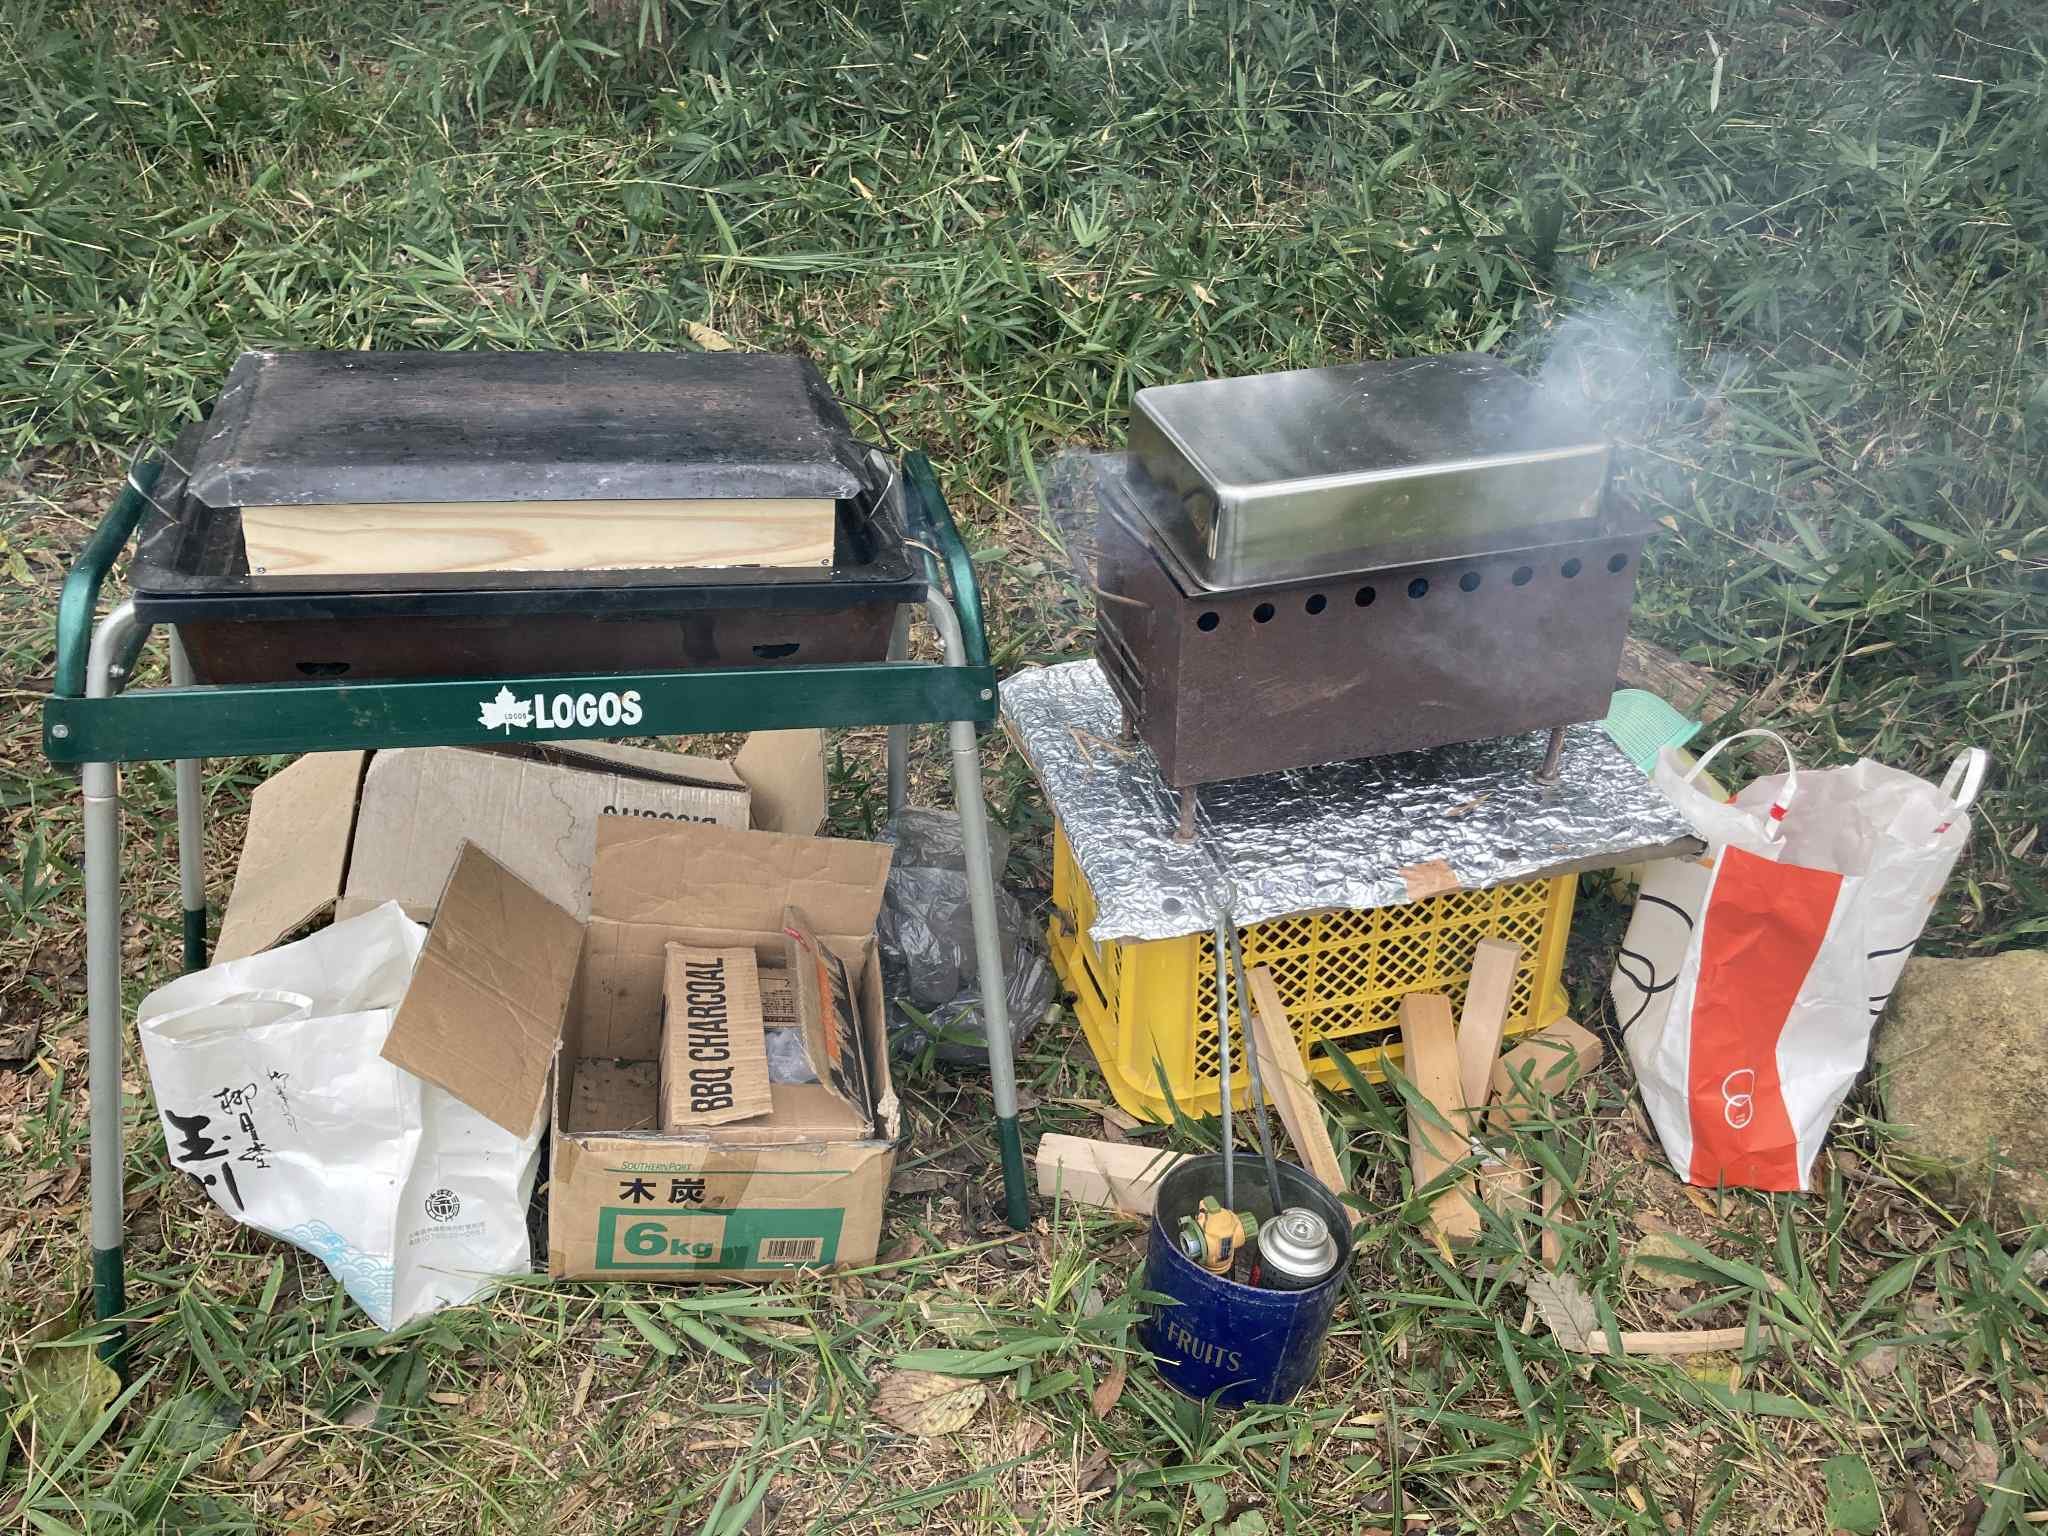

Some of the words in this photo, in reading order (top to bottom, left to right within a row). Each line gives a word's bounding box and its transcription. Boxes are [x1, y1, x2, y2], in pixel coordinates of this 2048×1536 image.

[534, 690, 643, 728] LOGOS
[686, 957, 731, 1061] CHARCOAL
[689, 1067, 735, 1112] BBQ
[619, 1178, 705, 1203] 木炭
[624, 1222, 713, 1258] 6kg
[1167, 1320, 1242, 1372] FRUITS
